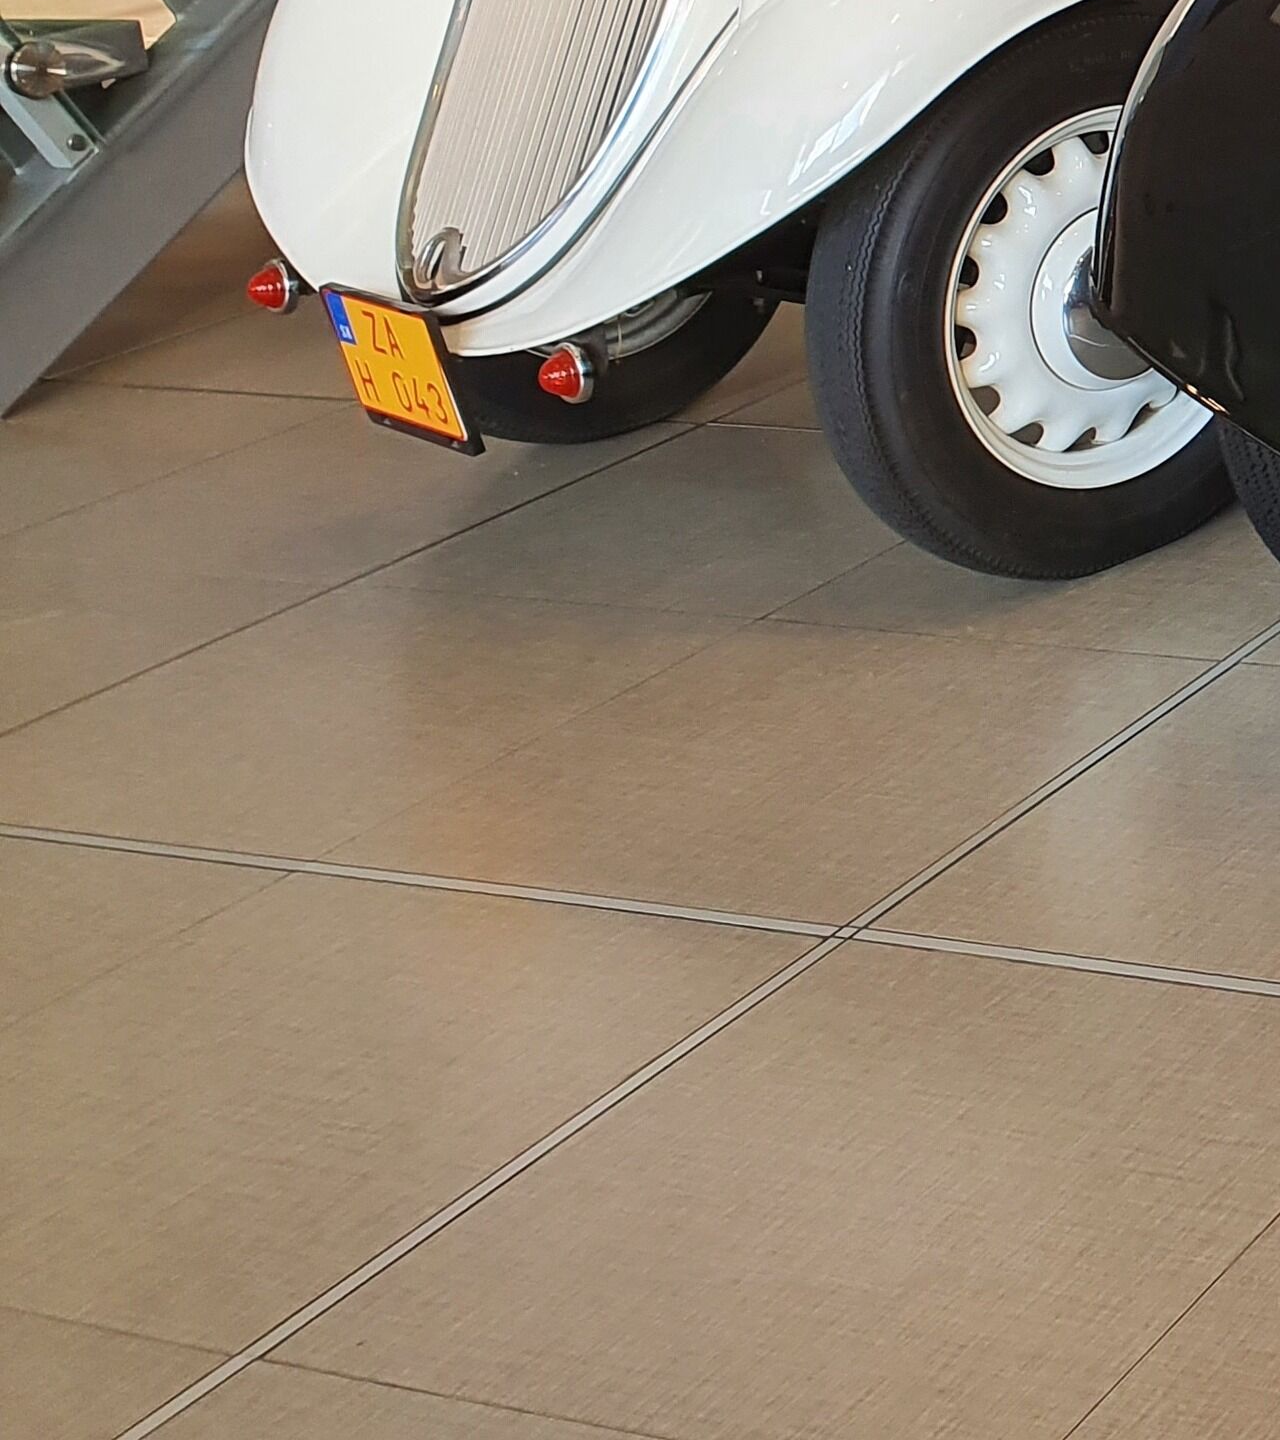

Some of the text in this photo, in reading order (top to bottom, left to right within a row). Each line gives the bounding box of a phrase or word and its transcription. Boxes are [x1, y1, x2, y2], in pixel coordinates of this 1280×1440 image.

[359, 310, 404, 360] ZA
[353, 359, 449, 425] H 043
